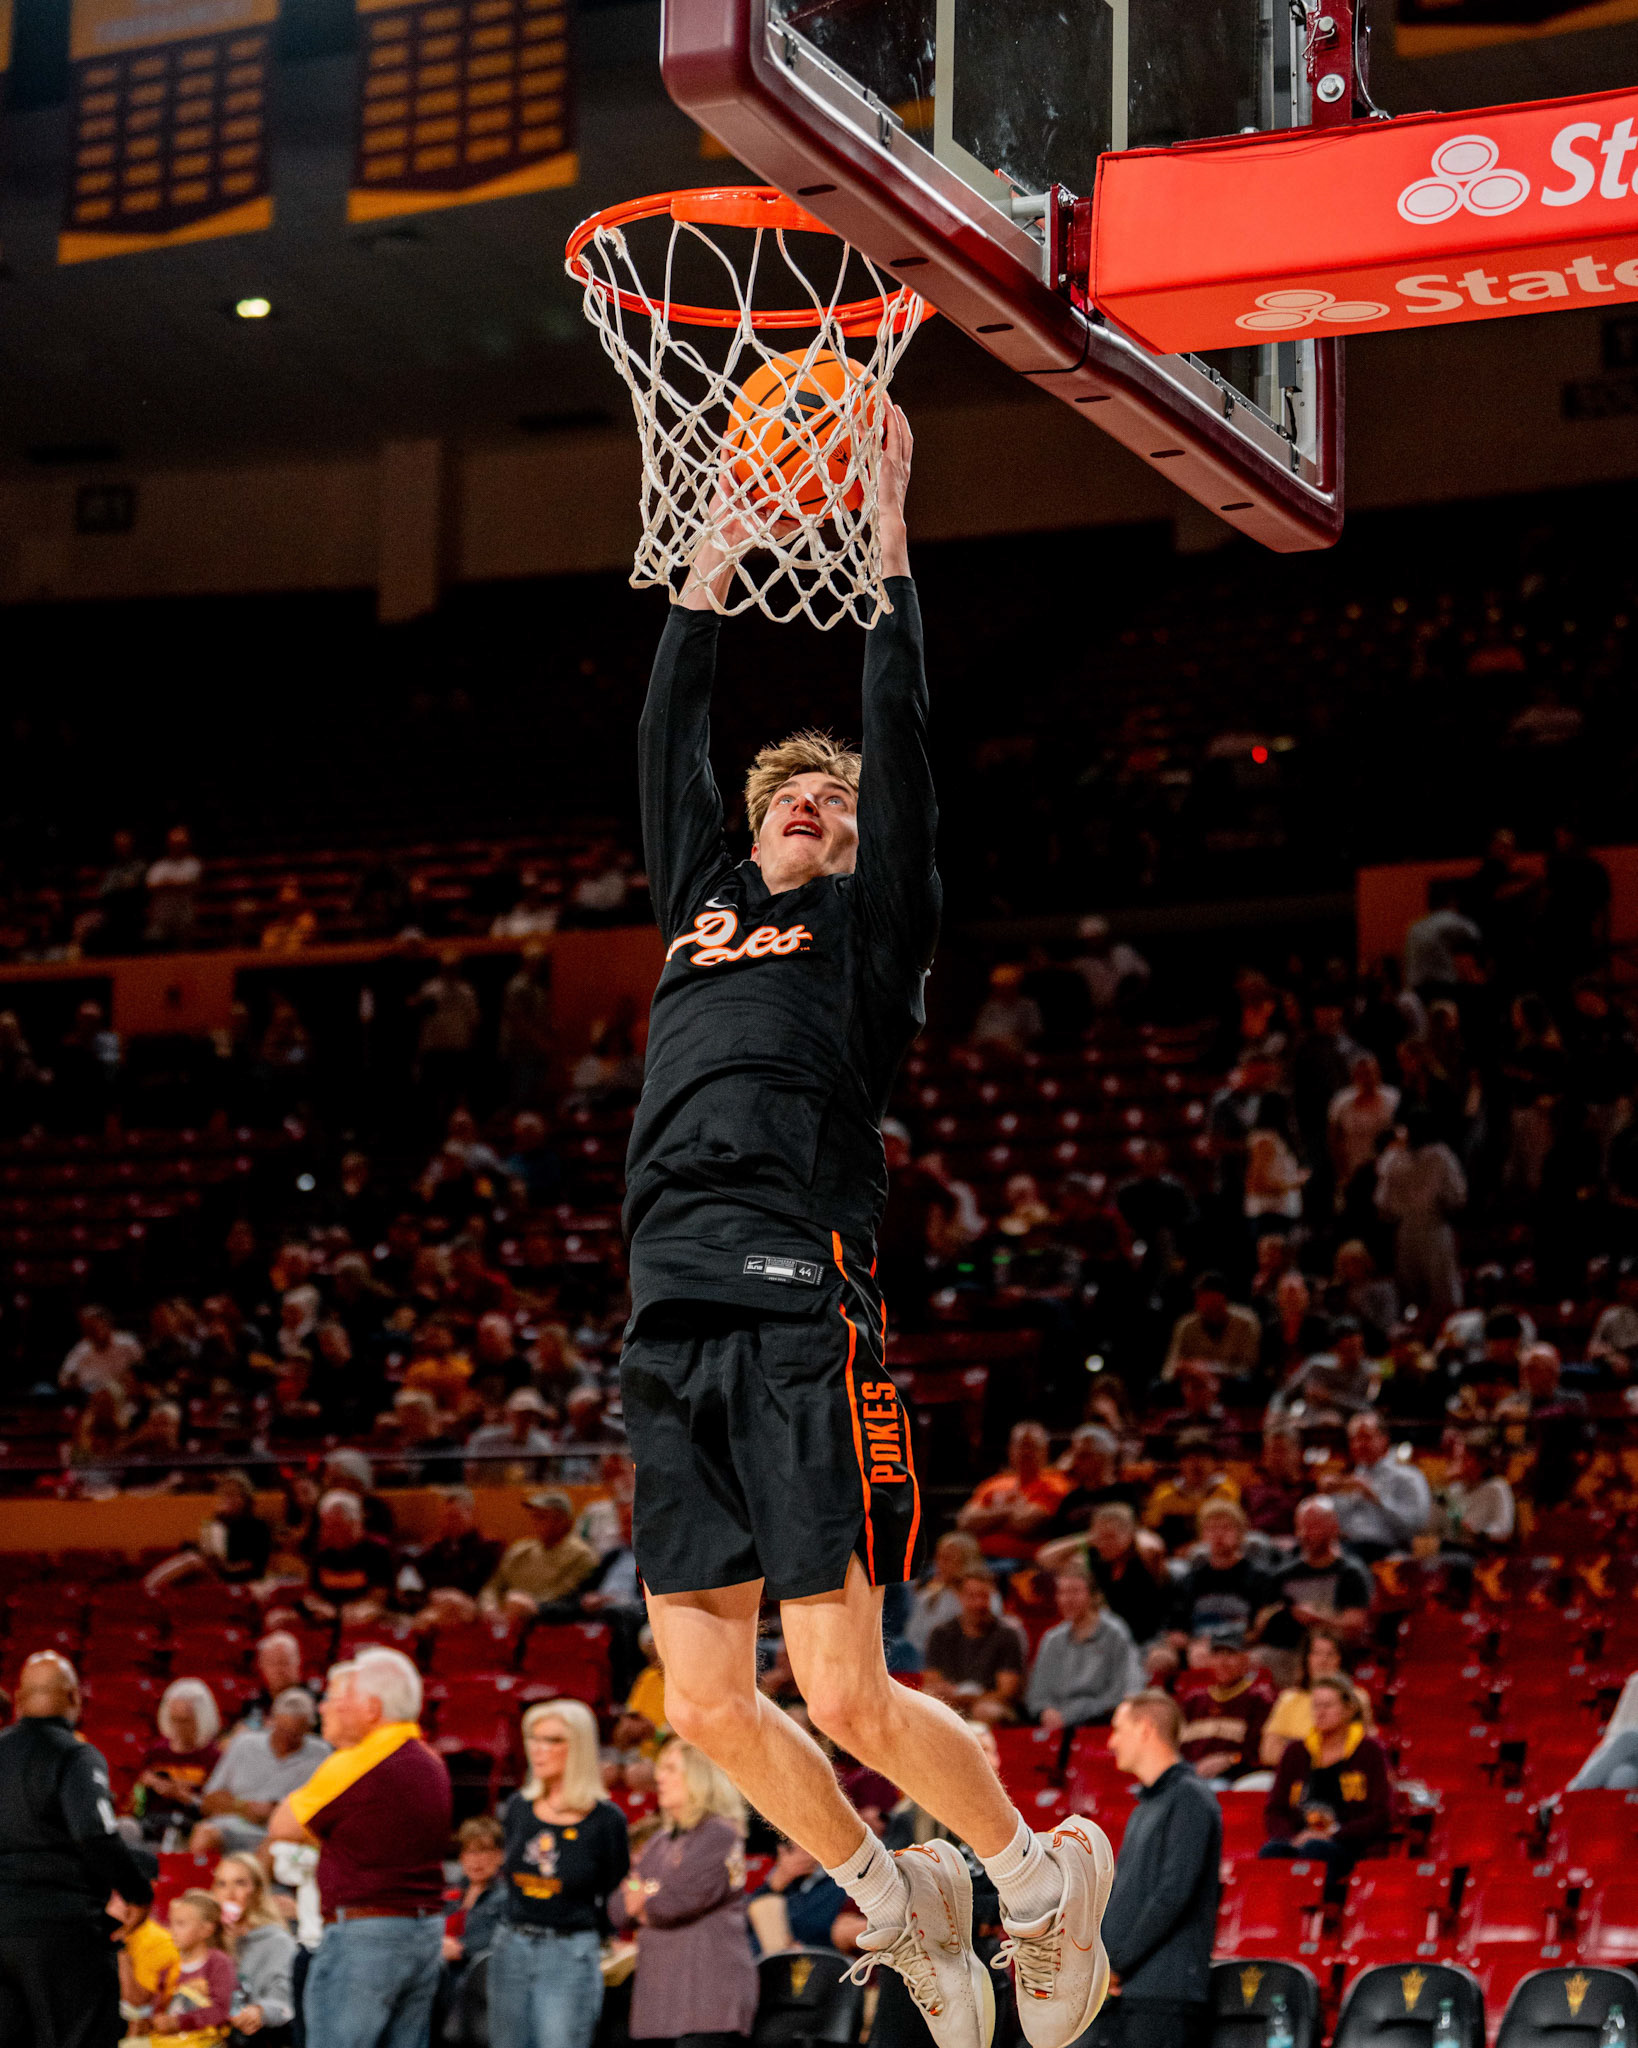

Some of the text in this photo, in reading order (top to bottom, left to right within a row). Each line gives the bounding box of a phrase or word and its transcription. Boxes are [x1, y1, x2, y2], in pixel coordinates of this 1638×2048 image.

[1540, 117, 1638, 207] St
[798, 1266, 812, 1277] 44
[861, 1381, 908, 1484] POKES
